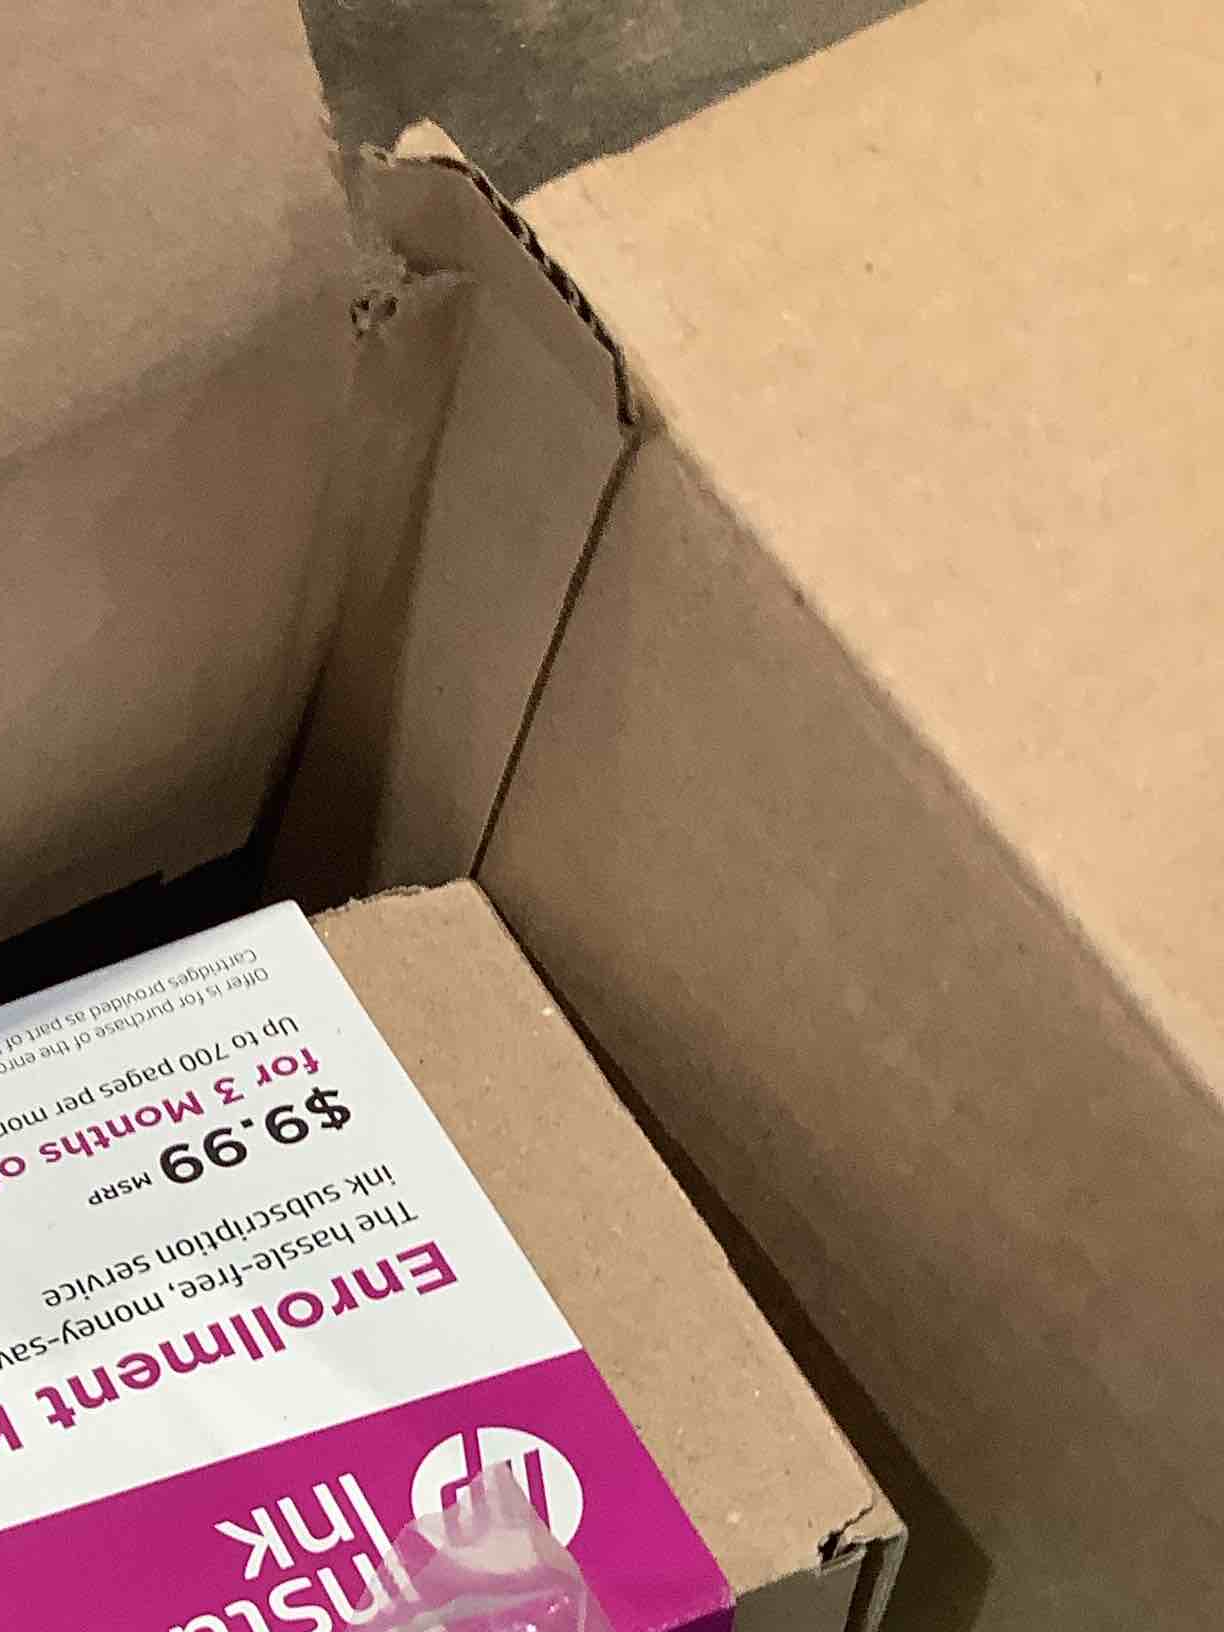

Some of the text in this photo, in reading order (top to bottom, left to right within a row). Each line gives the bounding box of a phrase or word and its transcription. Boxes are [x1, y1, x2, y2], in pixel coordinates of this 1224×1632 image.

[167, 949, 258, 989] Cartridges
[225, 967, 269, 991] Offer
[88, 979, 167, 1022] provided
[178, 991, 205, 1009] for
[204, 983, 224, 999] is
[19, 1010, 65, 1043] part
[64, 1005, 87, 1028] as
[93, 997, 176, 1039] purchase
[262, 1016, 300, 1038] Up
[38, 1039, 71, 1059] the
[72, 1031, 92, 1052] of
[231, 1031, 260, 1049] to
[178, 1042, 230, 1073] 700
[255, 1047, 320, 1088] for
[98, 1057, 175, 1099] pages
[213, 1076, 245, 1106] 3
[55, 1086, 96, 1116] per
[38, 1090, 205, 1164] Months
[87, 1086, 352, 1206] $9.99 MSRP
[355, 1200, 419, 1232] The
[41, 1164, 396, 1308] ink subscription service
[168, 1222, 356, 1299] hassle-free,
[34, 1240, 459, 1430] Enrollment
[215, 1473, 404, 1580] Ink
